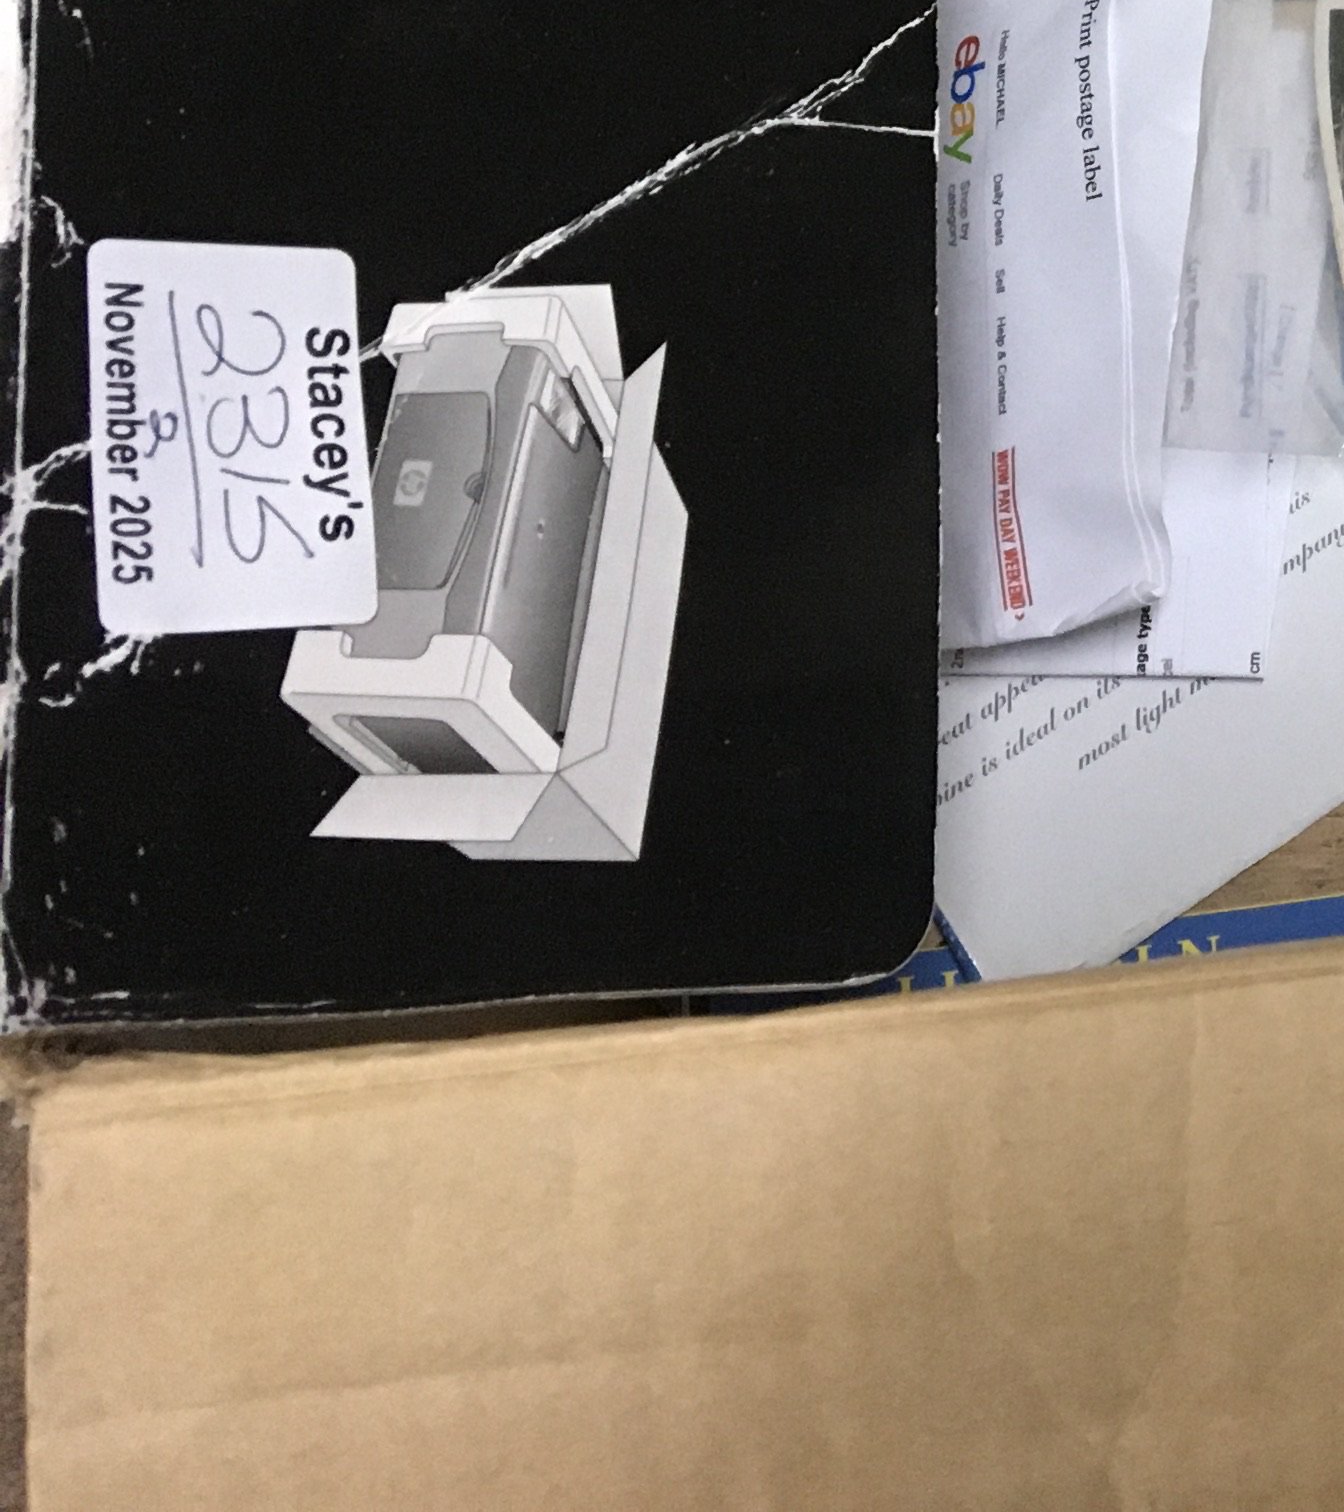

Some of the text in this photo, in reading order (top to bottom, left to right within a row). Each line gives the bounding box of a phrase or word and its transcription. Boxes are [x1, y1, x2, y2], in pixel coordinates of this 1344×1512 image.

[943, 35, 986, 164] ebay
[996, 63, 1006, 125] MICHAEL
[1074, 55, 1094, 140] postage
[992, 174, 1004, 207] Daily
[1082, 147, 1103, 202] label
[947, 184, 957, 247] category
[959, 180, 971, 241] Shop by
[994, 209, 1005, 246] Deals
[995, 269, 1006, 294] Sell
[995, 316, 1006, 347] Help
[998, 365, 1007, 415] Contact
[105, 282, 153, 584] November 2025
[144, 409, 178, 458] 2
[197, 304, 315, 563] 2315
[303, 327, 363, 541] Stacey's
[996, 449, 1009, 486] WOW
[998, 489, 1011, 515] PAY
[1000, 517, 1014, 544] DAY
[1137, 644, 1148, 676] age
[1250, 651, 1260, 674] cm
[981, 757, 998, 777] is
[1006, 707, 1056, 760] ideal
[1063, 697, 1089, 721] on
[1096, 677, 1121, 700] its
[1078, 723, 1129, 770] most
[1136, 687, 1181, 734] light
